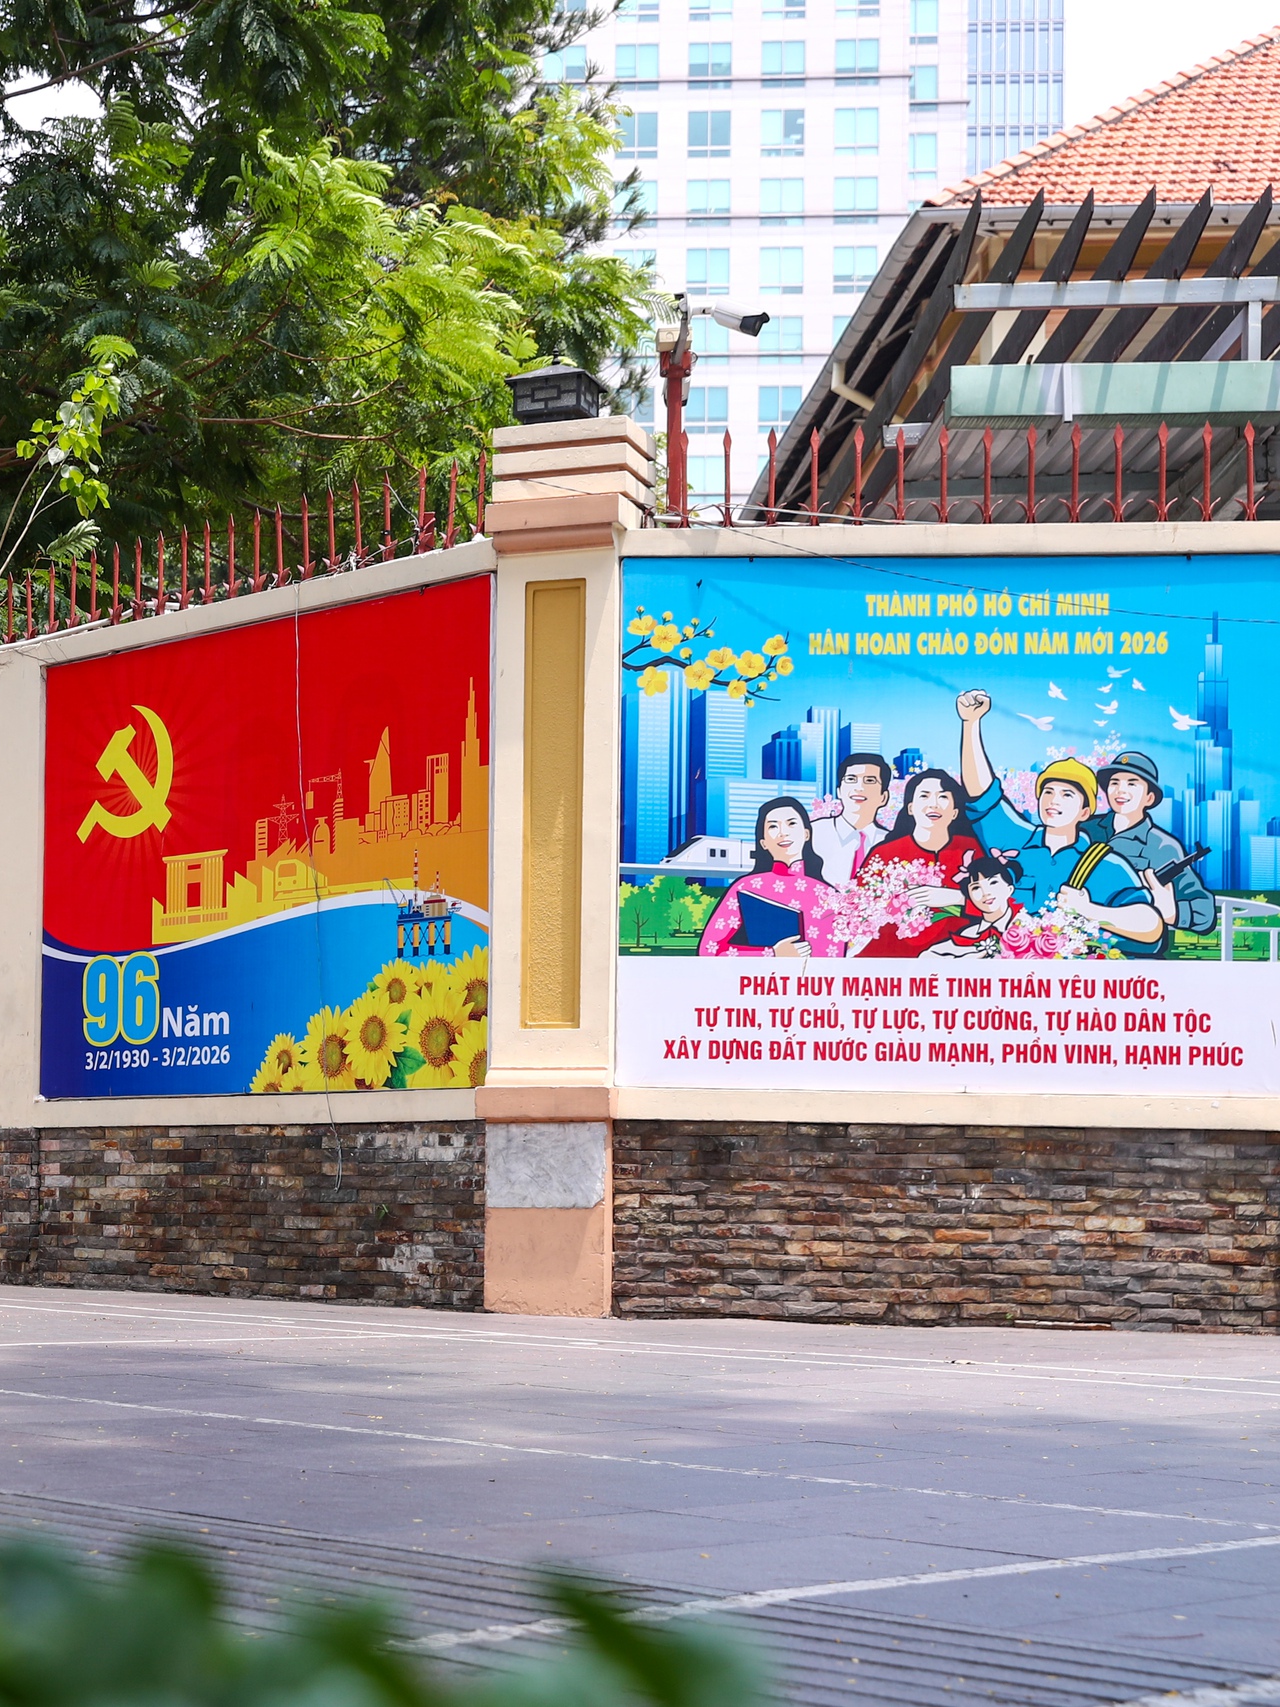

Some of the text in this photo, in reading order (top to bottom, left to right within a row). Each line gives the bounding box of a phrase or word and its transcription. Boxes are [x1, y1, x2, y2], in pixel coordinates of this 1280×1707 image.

[866, 586, 1110, 617] THÀNH PHỐ HỒ CHÍ MINH
[809, 626, 1169, 655] HÂN HOAN CHÀO ĐÓN NĂM MỚI 2026
[82, 951, 230, 1047] 96 Năm
[739, 971, 1166, 1002] PHÁT HUY MẠNH MẼ TINH THẦN YÊU NƯỚC,
[694, 1002, 1212, 1037] TỰ TIN, TỰ CHỦ, TỰ LỰC, TỰ CƯỜNG, TỰ HÀO DÂN TỘC
[84, 1048, 150, 1070] 3/2/1930
[161, 1044, 231, 1067] 3/2/2026
[663, 1033, 1244, 1070] XÂY DỰNG ĐẤT NƯỚC GIÀU MẠNH, PHỒN VINH, HẠNH PHÚC
